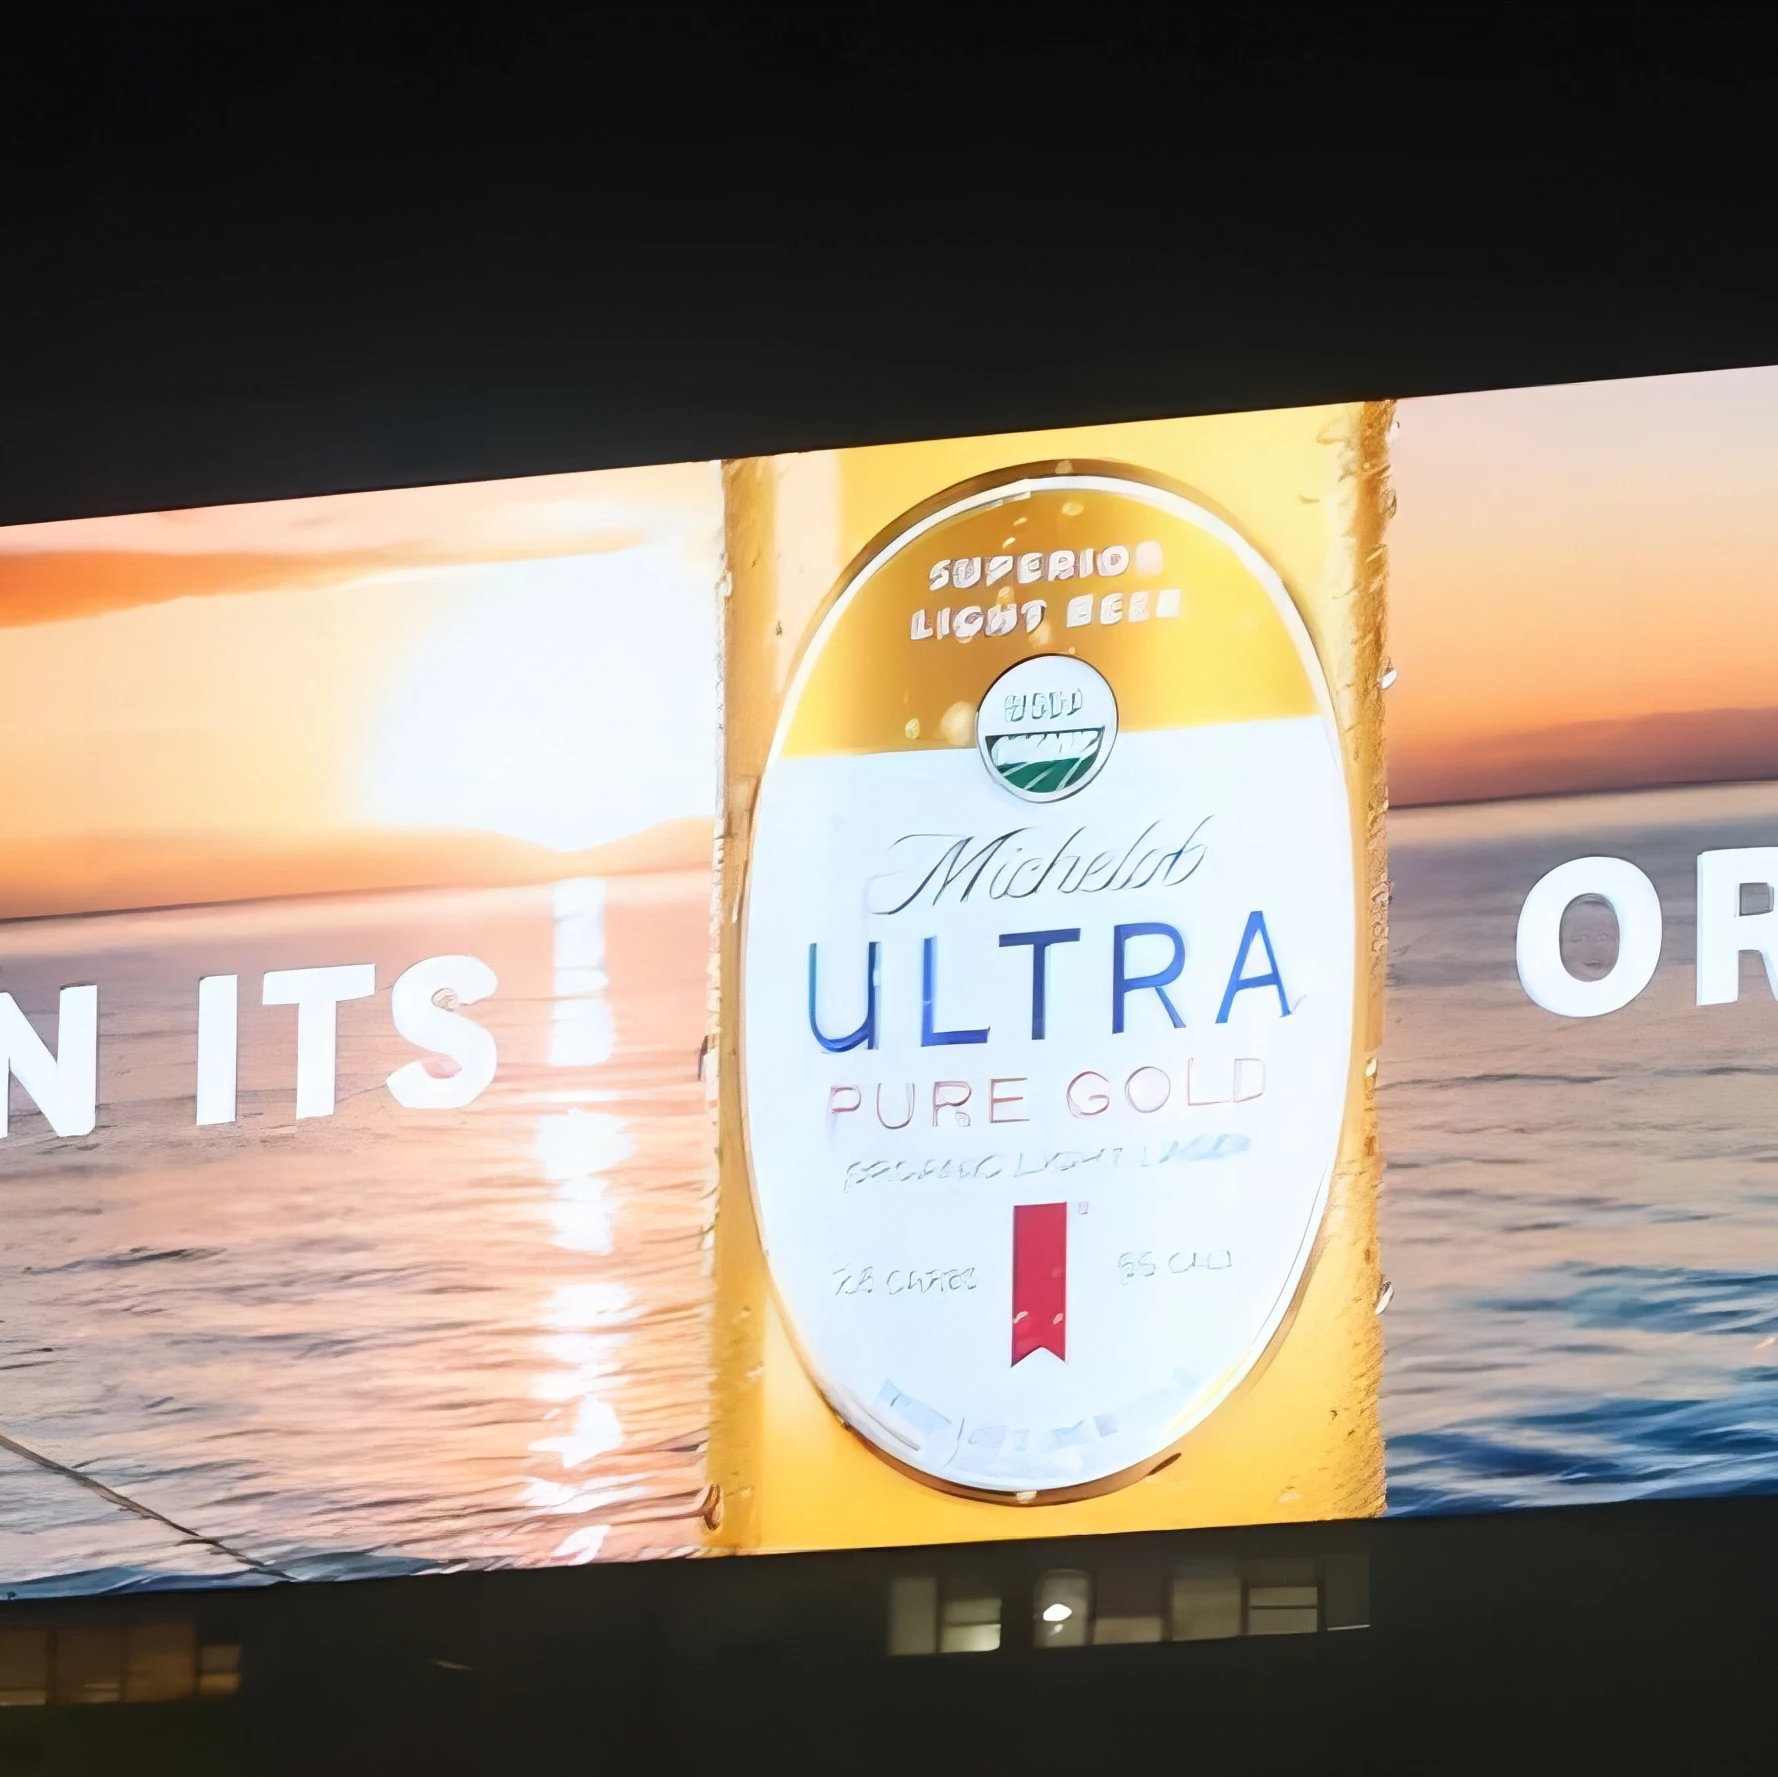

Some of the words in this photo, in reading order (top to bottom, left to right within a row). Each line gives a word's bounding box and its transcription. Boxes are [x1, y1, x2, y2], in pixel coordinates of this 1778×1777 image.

[910, 599, 1048, 641] LIGHT
[864, 814, 1215, 916] Michelob
[808, 910, 1293, 1053] ULTRA
[195, 954, 500, 1127] ITS
[826, 1076, 1030, 1130] PURE
[1065, 1057, 1267, 1120] GOLD
